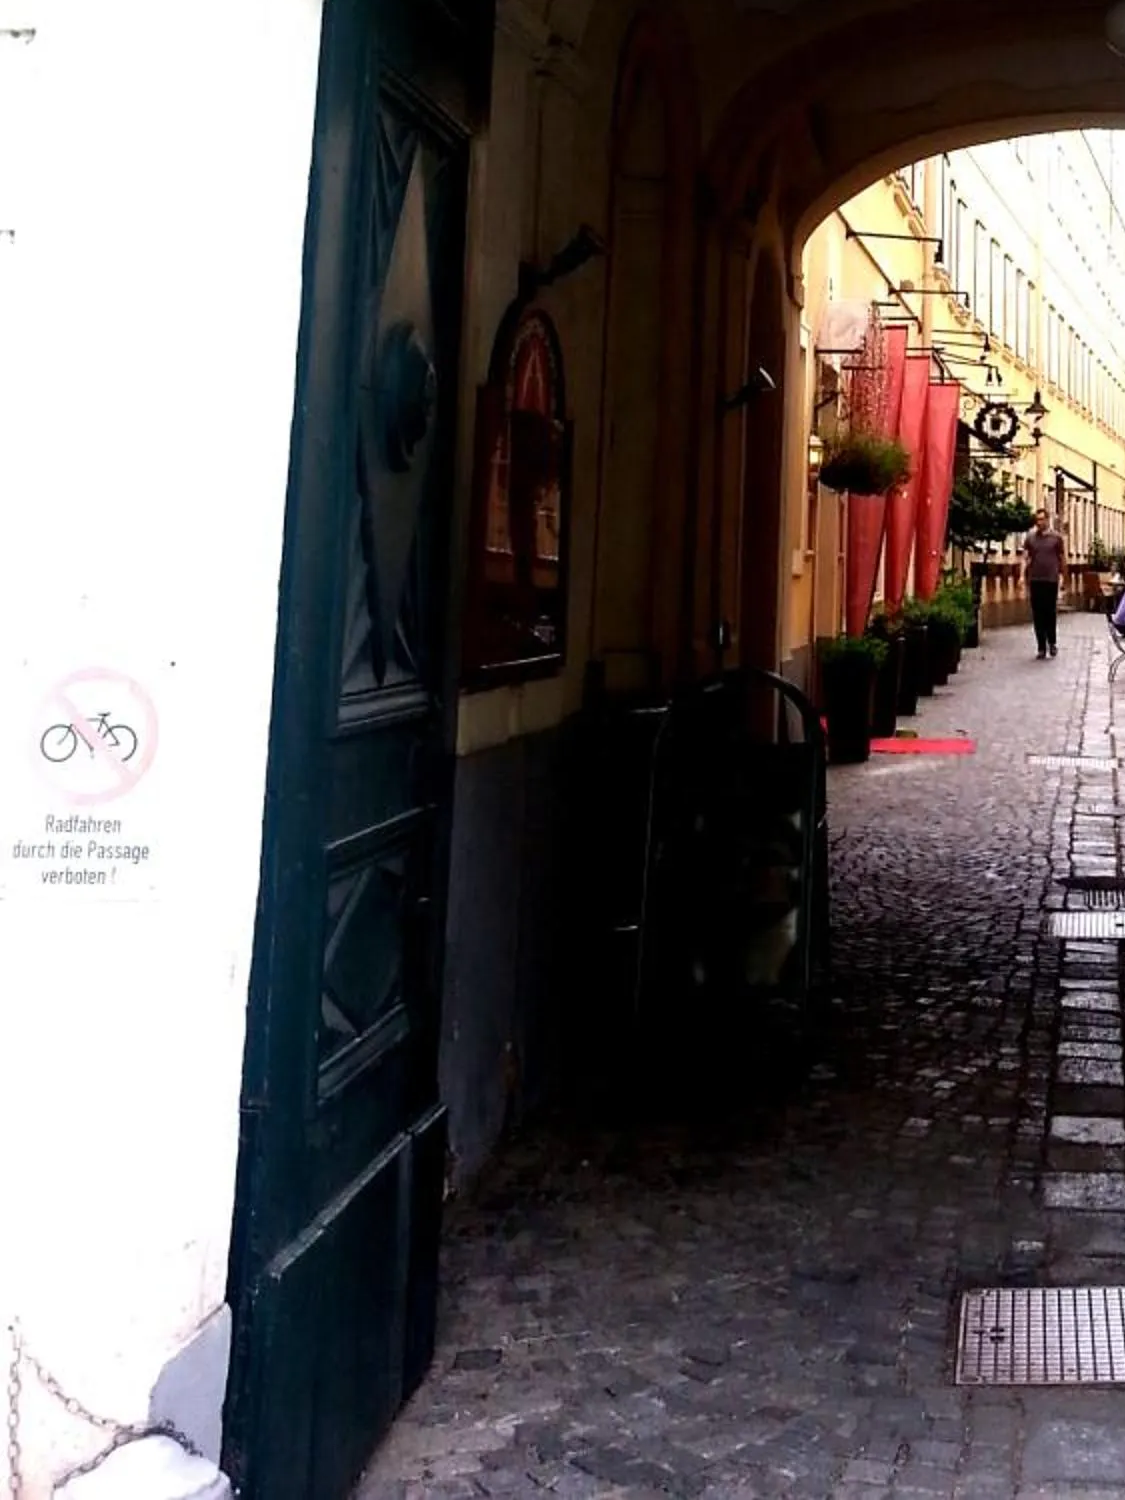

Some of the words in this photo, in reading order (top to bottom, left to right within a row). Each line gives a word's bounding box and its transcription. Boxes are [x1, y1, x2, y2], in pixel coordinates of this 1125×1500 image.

[46, 814, 122, 835] Radfahren
[13, 840, 56, 860] durch
[60, 840, 84, 860] die
[87, 840, 151, 865] Passage
[41, 866, 107, 886] verboten
